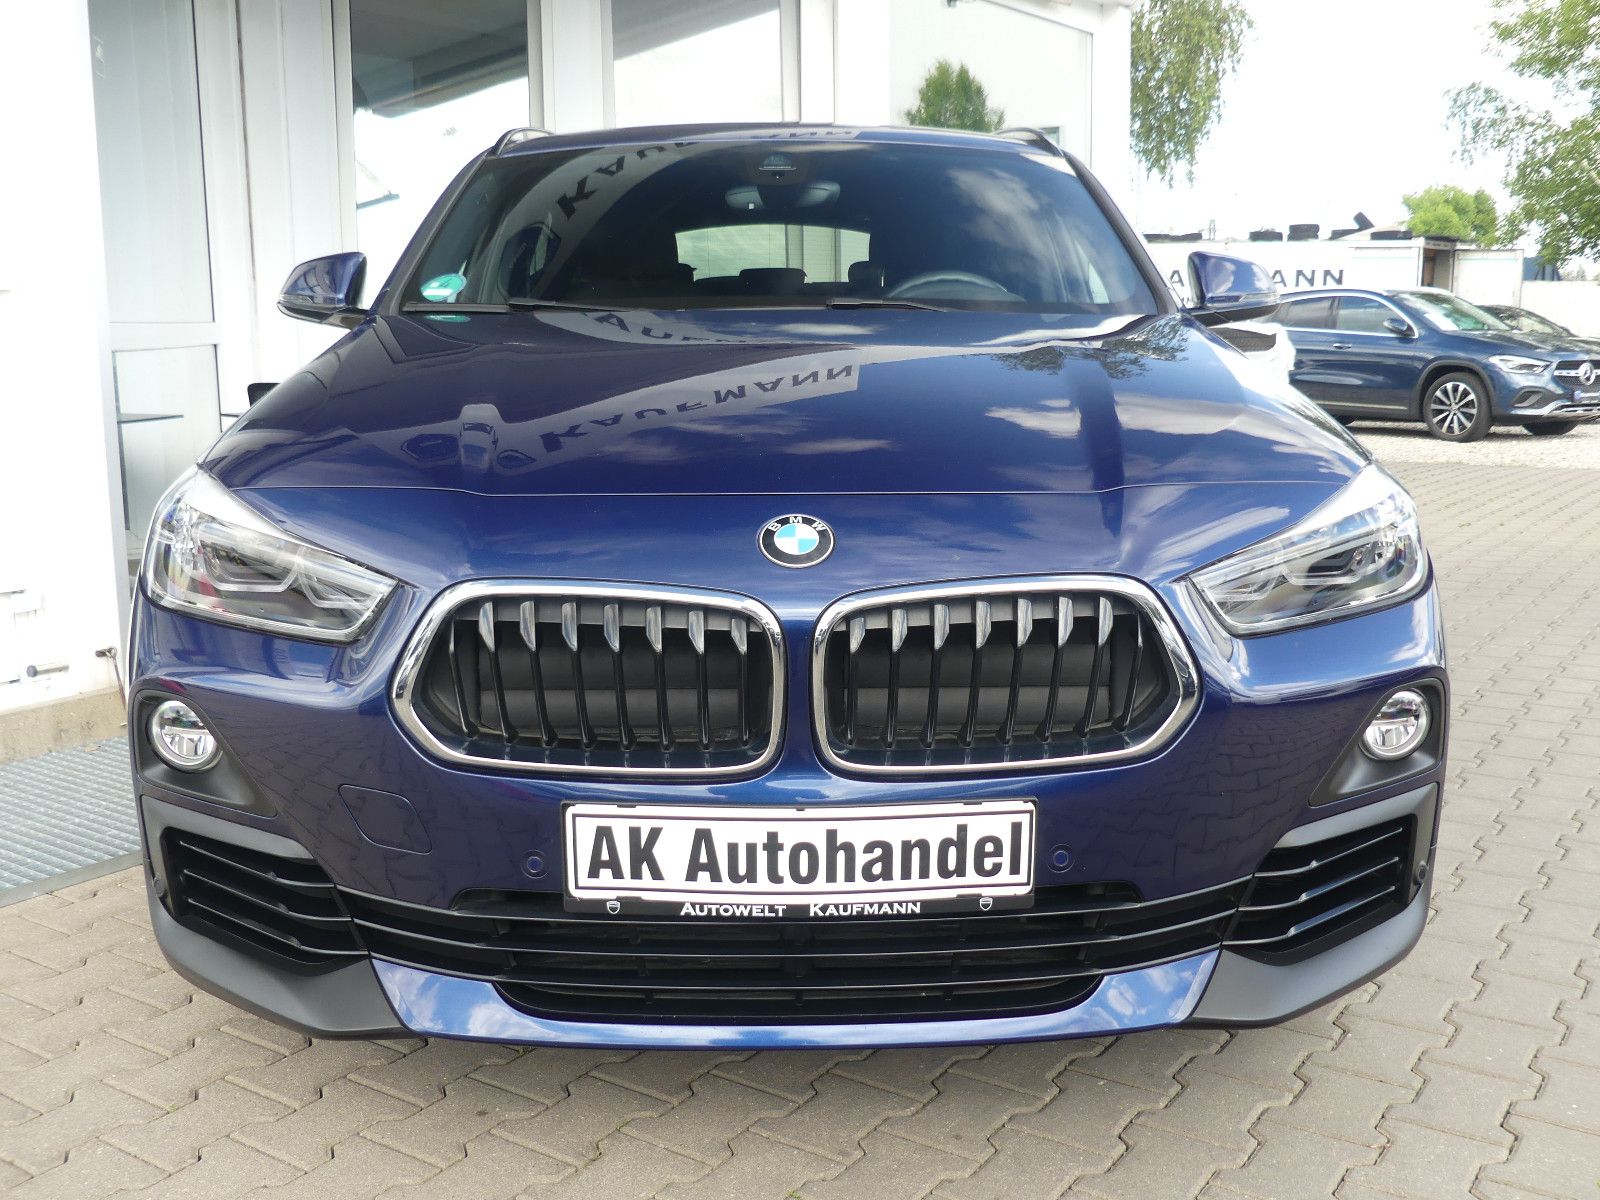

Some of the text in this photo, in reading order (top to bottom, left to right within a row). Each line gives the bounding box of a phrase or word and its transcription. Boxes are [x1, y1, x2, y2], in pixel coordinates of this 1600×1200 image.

[768, 516, 826, 532] BMW
[587, 821, 1023, 884] AK Autohandel
[680, 901, 922, 917] AUTOWELT KAUFMANN
